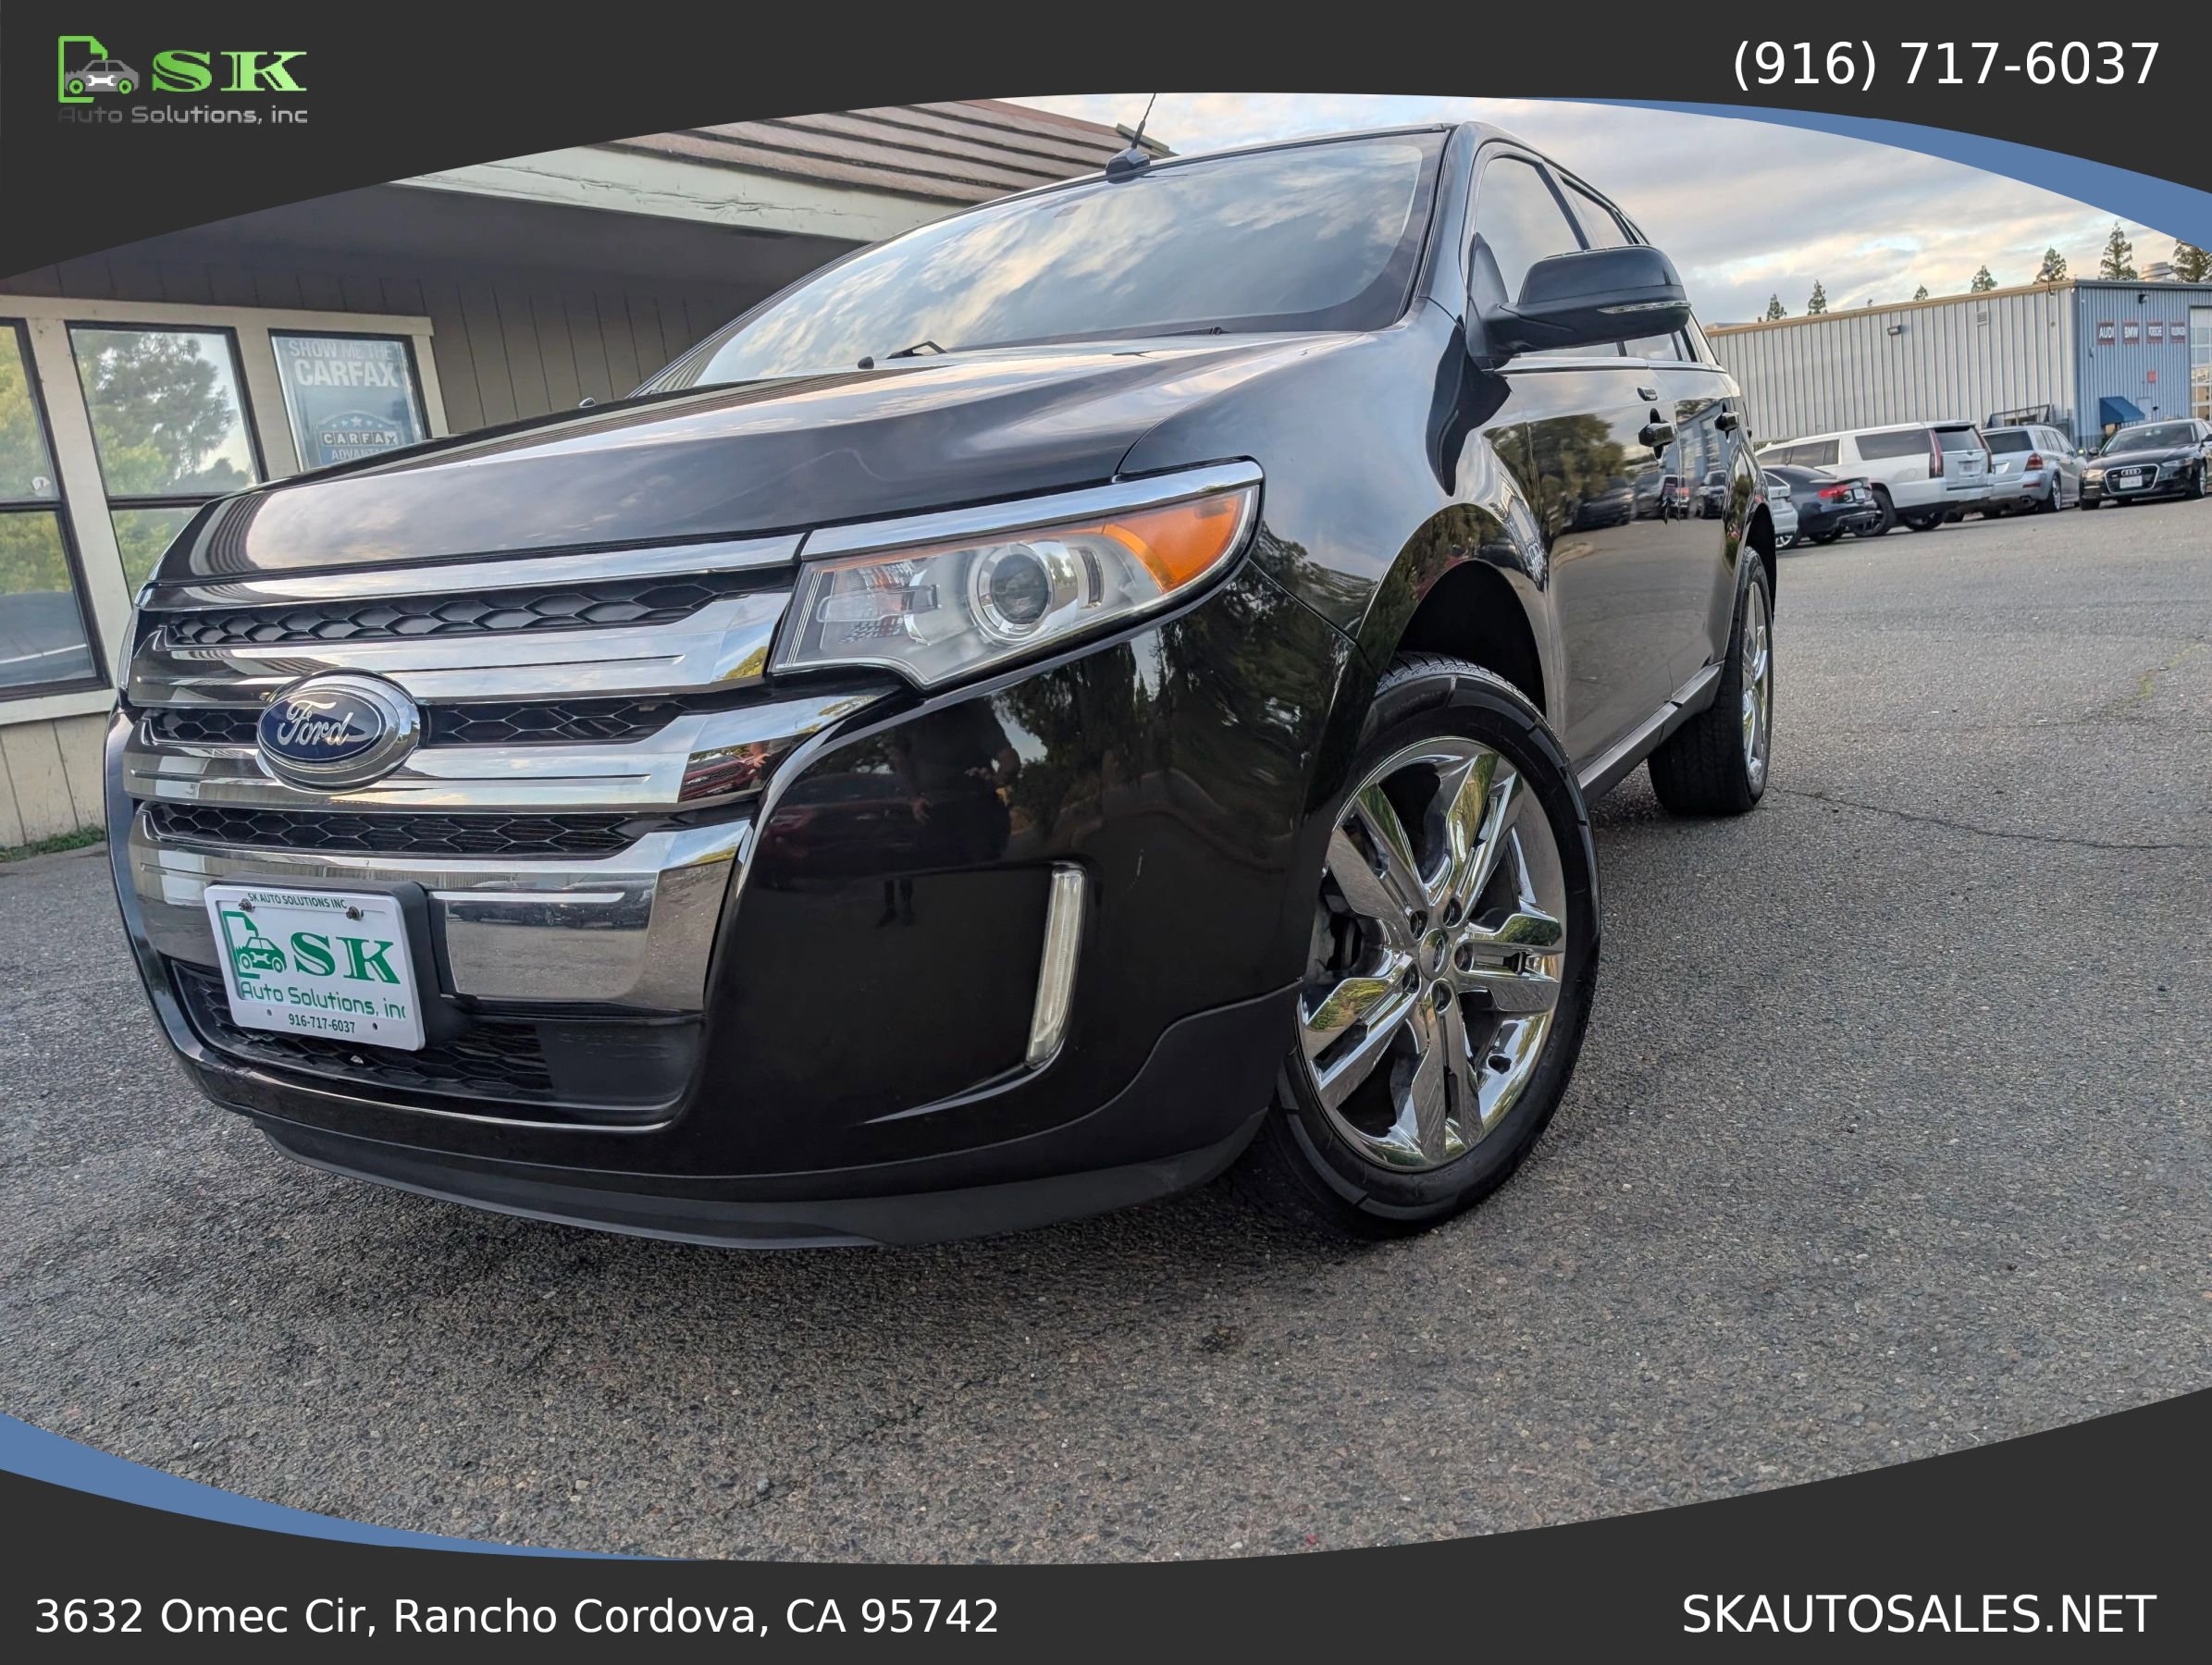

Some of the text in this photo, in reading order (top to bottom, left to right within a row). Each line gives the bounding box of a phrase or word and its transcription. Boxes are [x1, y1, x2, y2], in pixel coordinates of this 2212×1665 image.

[2124, 326, 2139, 339] BMW
[289, 339, 393, 360] SHOW ME THE
[294, 359, 399, 388] CARFAX
[324, 432, 395, 445] CARFAX
[278, 699, 354, 746] Ford
[247, 893, 348, 909] SK AUTO SOLUTIONS INC
[290, 931, 401, 985] SK
[241, 980, 285, 1003] Auto
[289, 986, 380, 1017] Solutions,
[289, 1013, 355, 1034] 916-717-6037
